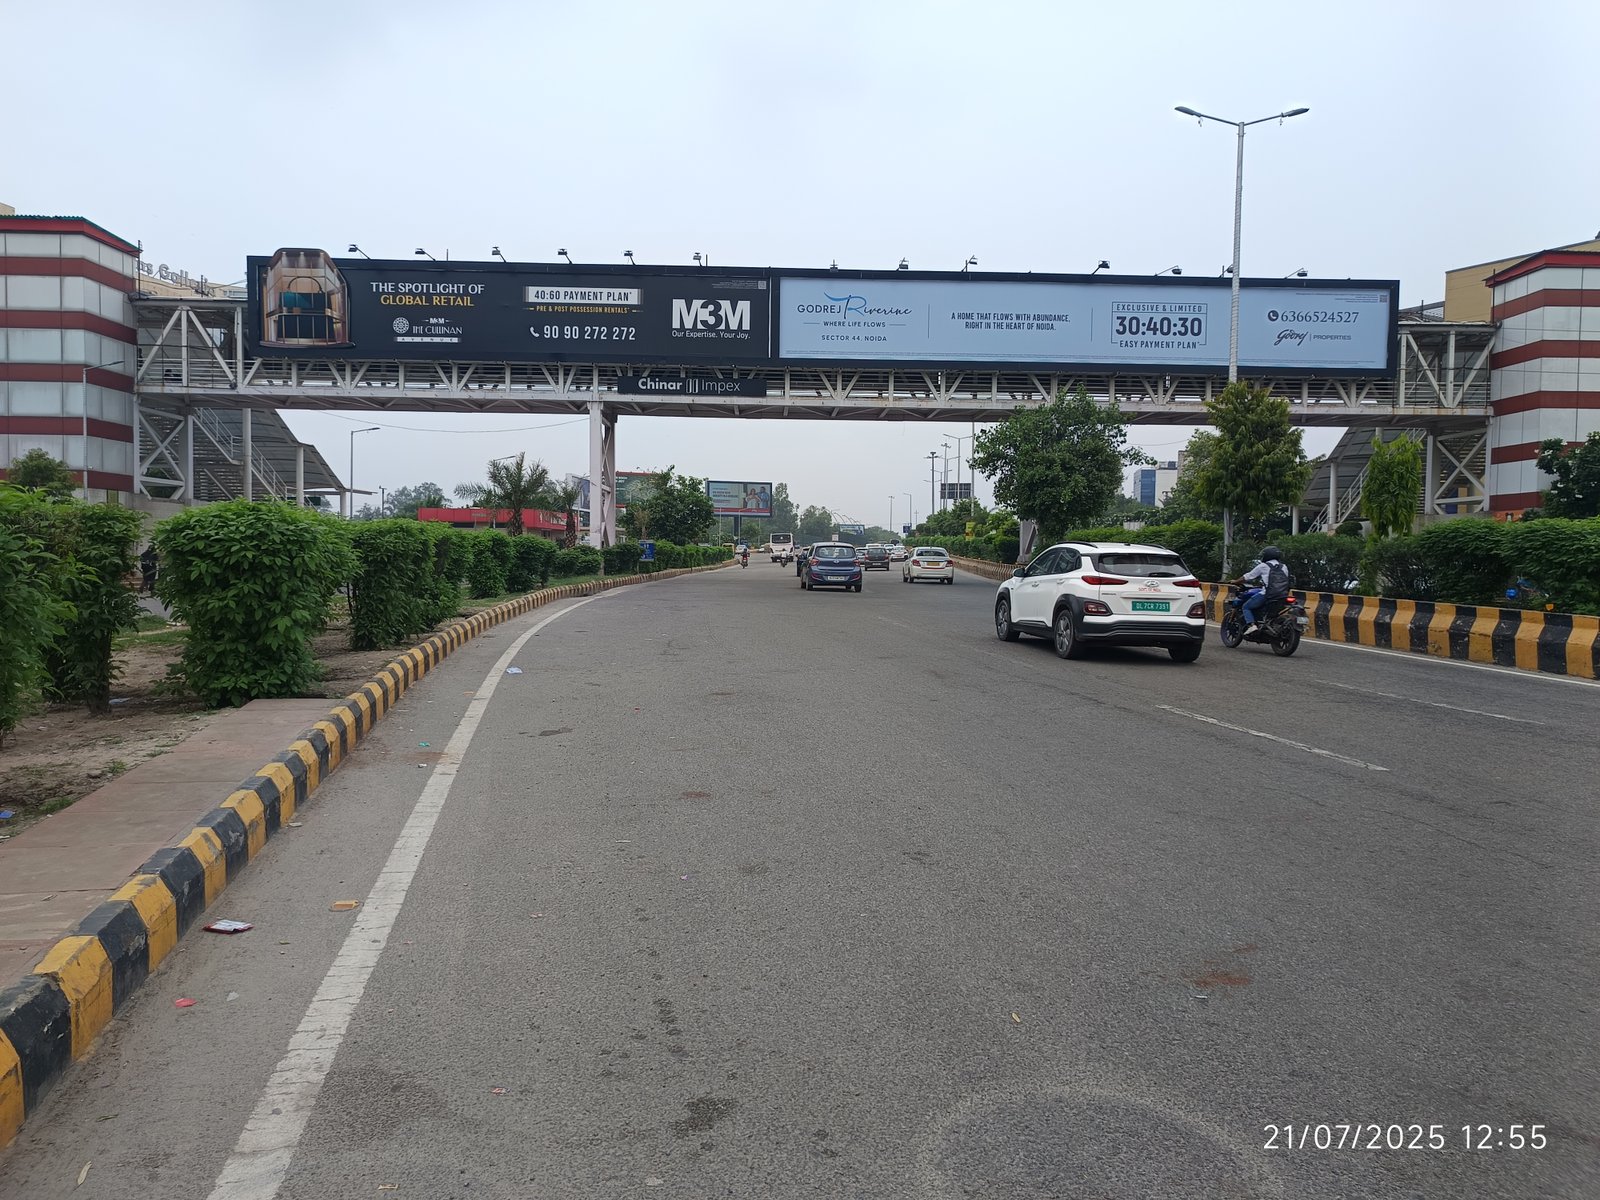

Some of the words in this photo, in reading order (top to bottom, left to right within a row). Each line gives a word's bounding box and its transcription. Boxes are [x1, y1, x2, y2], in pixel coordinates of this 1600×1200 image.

[370, 282, 396, 293] THE
[398, 282, 466, 294] SPOTLIGHT
[468, 284, 485, 294] OF
[380, 294, 430, 306] GLOBAL
[432, 296, 474, 306] RETAIL
[534, 290, 560, 300] 40:60
[564, 290, 604, 301] PAYMENT
[797, 304, 842, 314] GODREJ
[823, 291, 912, 320] Riverine
[1116, 304, 1160, 312] EXCLUSIVE
[1170, 304, 1202, 312] LIMITED
[672, 298, 750, 330] M3M
[957, 312, 974, 320] HOME
[976, 312, 992, 320] THAT
[993, 313, 1014, 321] FLOWS
[1015, 314, 1030, 322] WITH
[1281, 310, 1360, 324] 6366524527
[425, 326, 463, 334] CULLINAN
[965, 321, 983, 329] RIGHT
[1006, 322, 1025, 330] HEART
[1116, 316, 1202, 336] 30:40:30
[544, 325, 559, 339] 90
[564, 326, 579, 339] 90
[584, 326, 607, 340] 272
[612, 327, 636, 340] 272
[686, 330, 718, 339] Expertise.
[736, 332, 751, 340] Joy.
[1120, 340, 1138, 348] EASY
[1140, 340, 1175, 349] PAYMENT
[638, 378, 683, 390] Chinar
[702, 380, 741, 394] Impex
